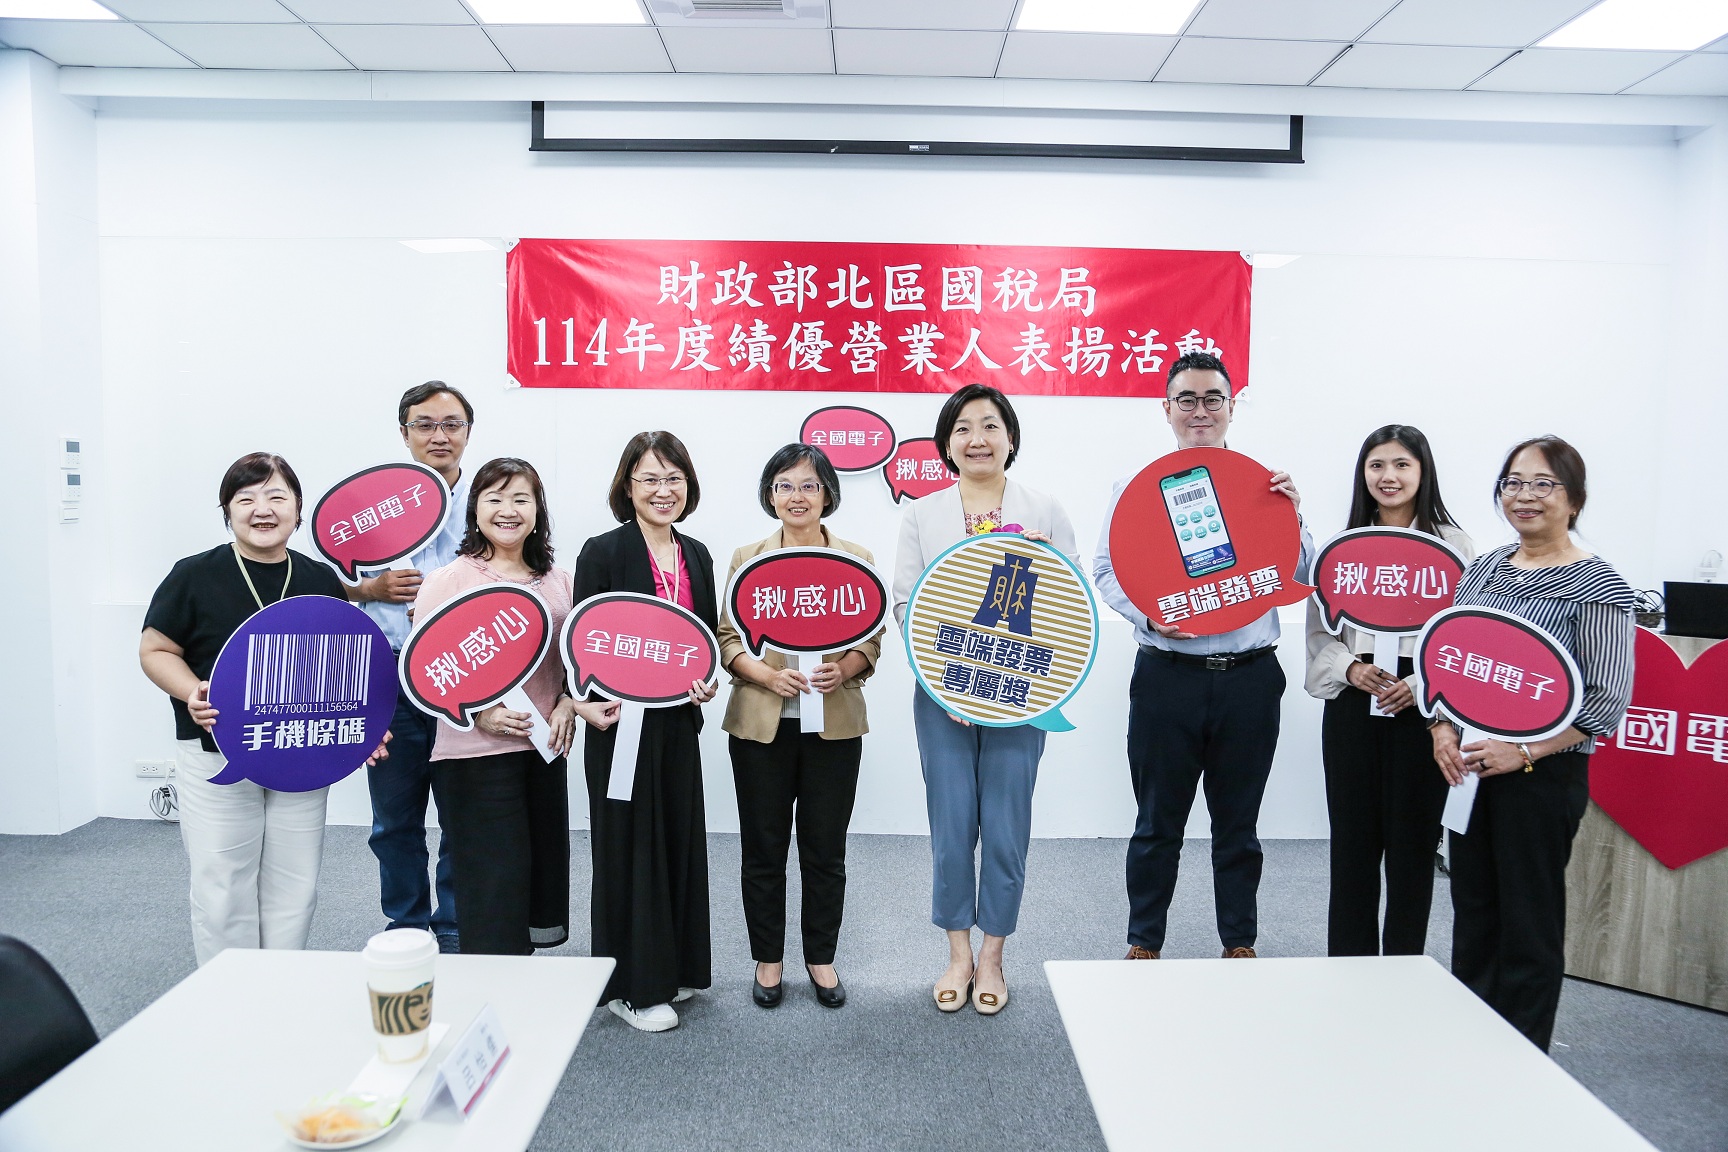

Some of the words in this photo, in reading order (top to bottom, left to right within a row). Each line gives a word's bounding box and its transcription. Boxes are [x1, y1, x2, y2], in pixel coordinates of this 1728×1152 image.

[657, 260, 1097, 317] 財政部北區國稅局
[810, 430, 885, 447] 全國電子
[329, 483, 427, 547] 全國電子
[752, 583, 866, 620] 揪感心
[1157, 565, 1283, 624] 雲端發票
[1333, 561, 1448, 599] 揪感心
[425, 606, 530, 696] 揪感心
[583, 629, 699, 667] 全國電子
[934, 622, 1055, 676] 雲端發票
[1434, 644, 1555, 701] 全國電子
[942, 660, 1031, 708] 專屬獎
[242, 717, 366, 751] 手機條碼
[1594, 705, 1728, 763] 國電
